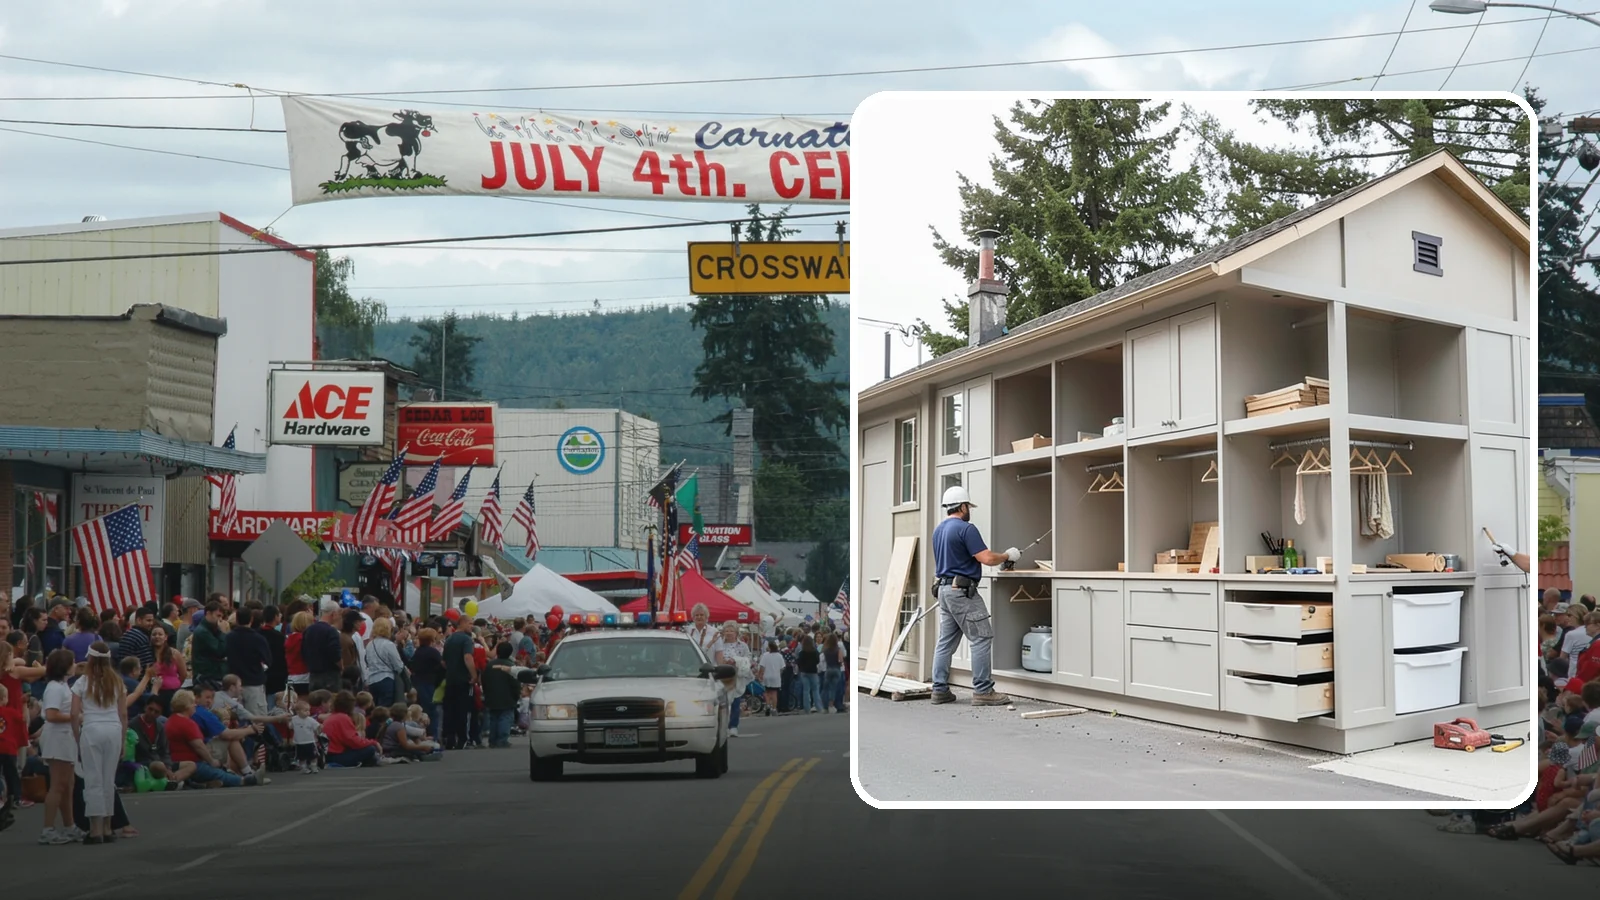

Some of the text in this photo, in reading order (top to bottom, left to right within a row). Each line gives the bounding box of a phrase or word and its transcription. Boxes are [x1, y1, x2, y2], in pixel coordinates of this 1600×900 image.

[481, 141, 604, 192] JULY
[632, 150, 747, 197] 4th.
[697, 254, 850, 280] CROSSWA
[283, 380, 373, 420] ACE
[405, 409, 453, 422] CEDAR
[284, 421, 371, 436] Hardware
[416, 428, 477, 447] Coca-Cola
[95, 484, 124, 495] Vincent
[126, 485, 135, 495] de
[137, 485, 155, 496] Paul
[688, 526, 741, 535] CRNATION
[699, 535, 730, 544] GLASS
